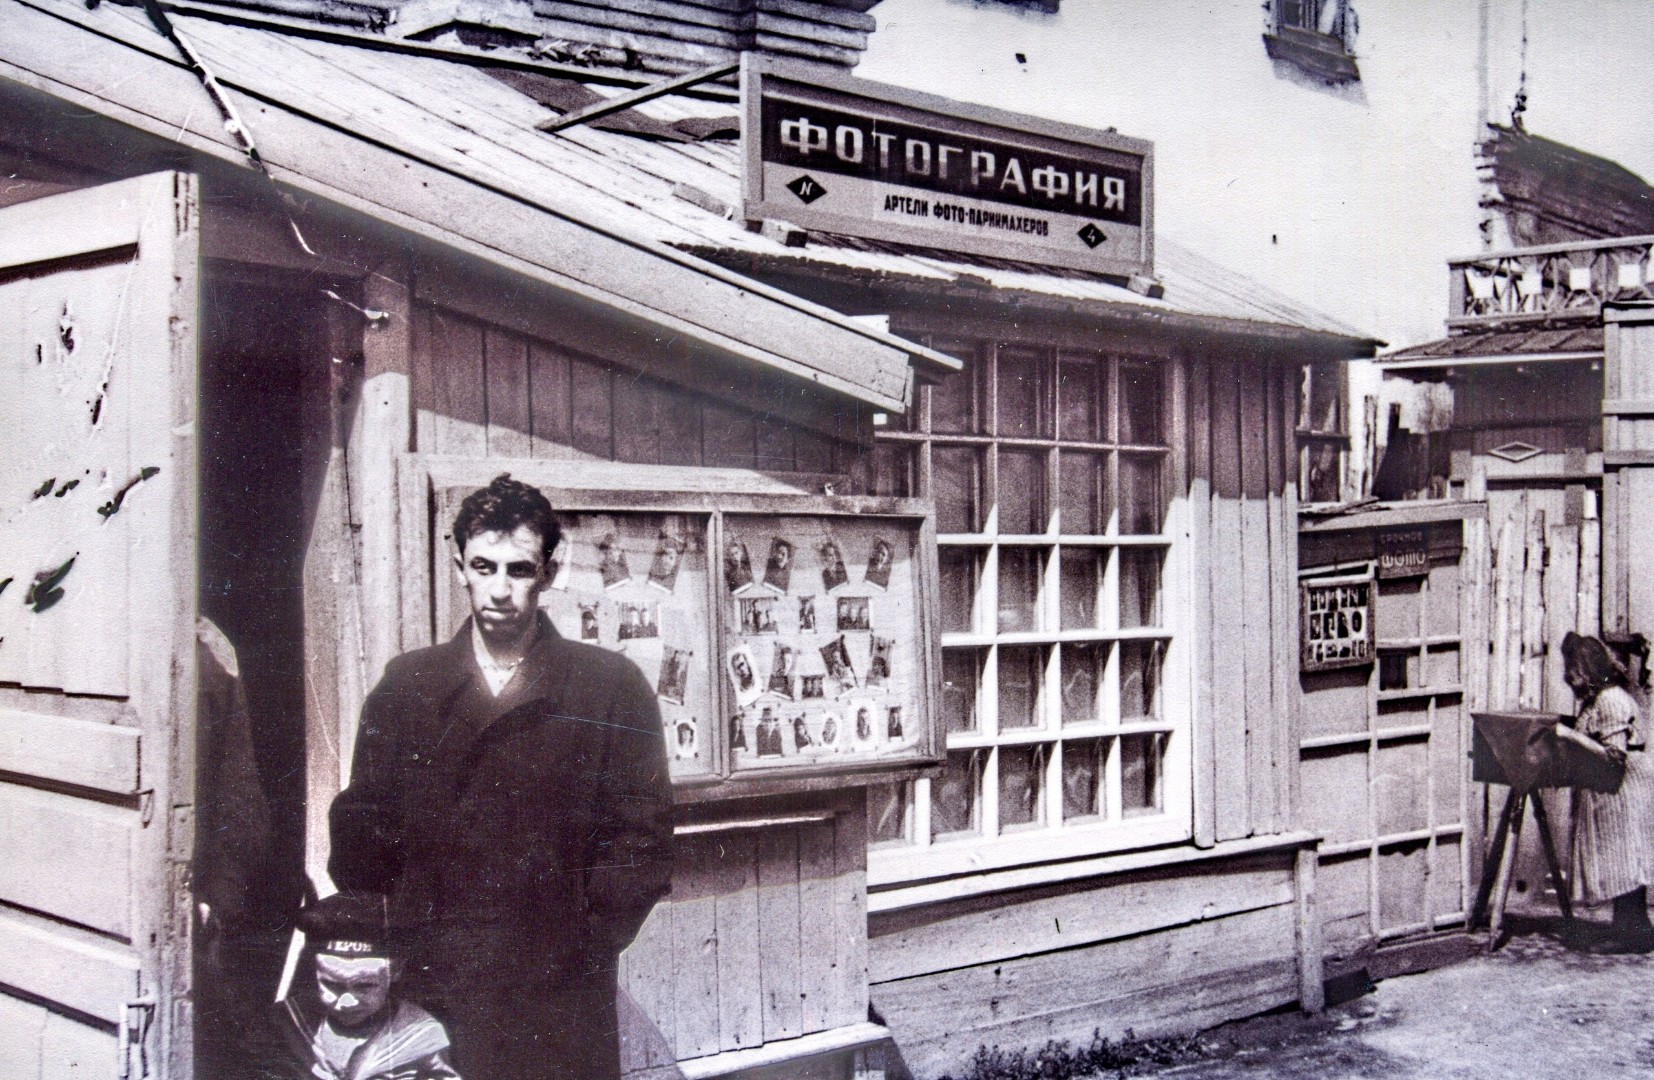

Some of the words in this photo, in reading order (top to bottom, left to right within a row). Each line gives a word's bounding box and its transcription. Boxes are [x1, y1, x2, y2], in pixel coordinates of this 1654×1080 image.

[780, 116, 1126, 212] ФОТОГРАФИЯ
[884, 194, 929, 217] АРТЕЛИ
[933, 201, 1049, 236] ФОТО-ПАРИКМАХЕРОВ
